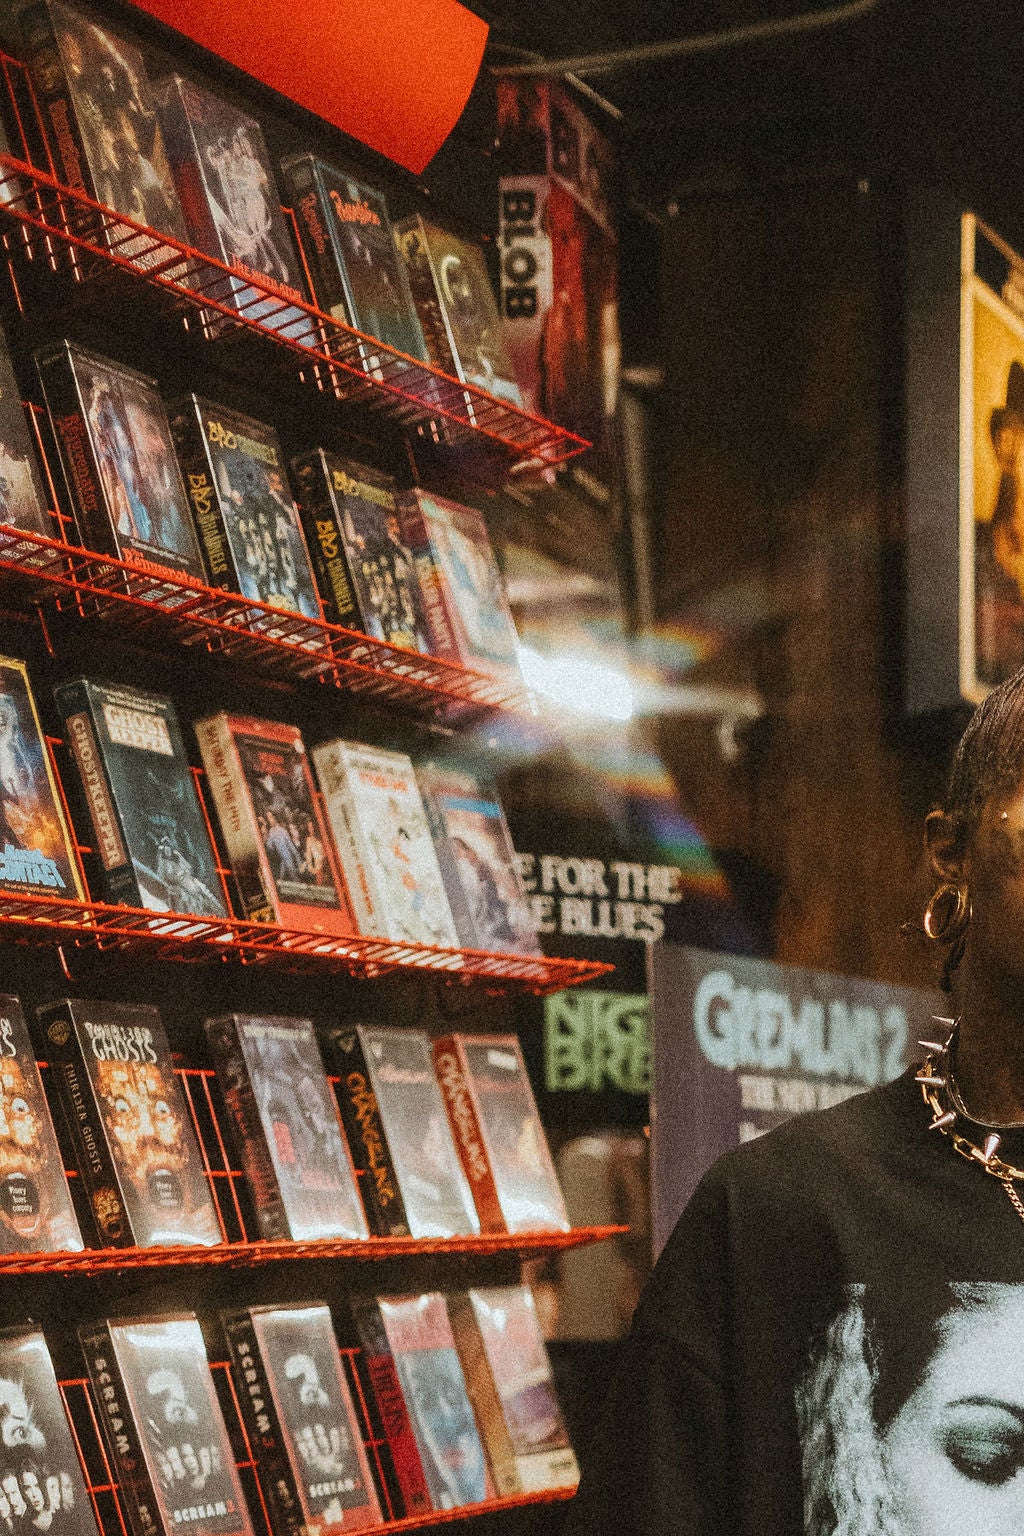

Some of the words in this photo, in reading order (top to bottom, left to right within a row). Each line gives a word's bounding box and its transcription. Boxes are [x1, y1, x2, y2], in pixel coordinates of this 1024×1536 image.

[502, 190, 537, 318] BLOB
[207, 420, 237, 449] BAD
[189, 474, 210, 514] BAD
[200, 511, 228, 574] CHANNELS
[315, 519, 338, 558] BAD
[328, 557, 354, 616] CHANNELS
[540, 855, 610, 898] FOR
[609, 861, 683, 904] THE
[559, 898, 666, 941] BLUES
[91, 1033, 158, 1063] GHOSTS
[544, 990, 653, 1044] NIG
[876, 1004, 910, 1084] 2
[544, 1040, 655, 1096] BRE
[64, 1062, 87, 1120] THIR13EN
[82, 1126, 103, 1173] GHOSTS
[95, 1358, 130, 1455] SCREAM
[237, 1342, 271, 1433] SCREAM
[262, 1436, 276, 1448] 3
[173, 1504, 227, 1524] SCREAM
